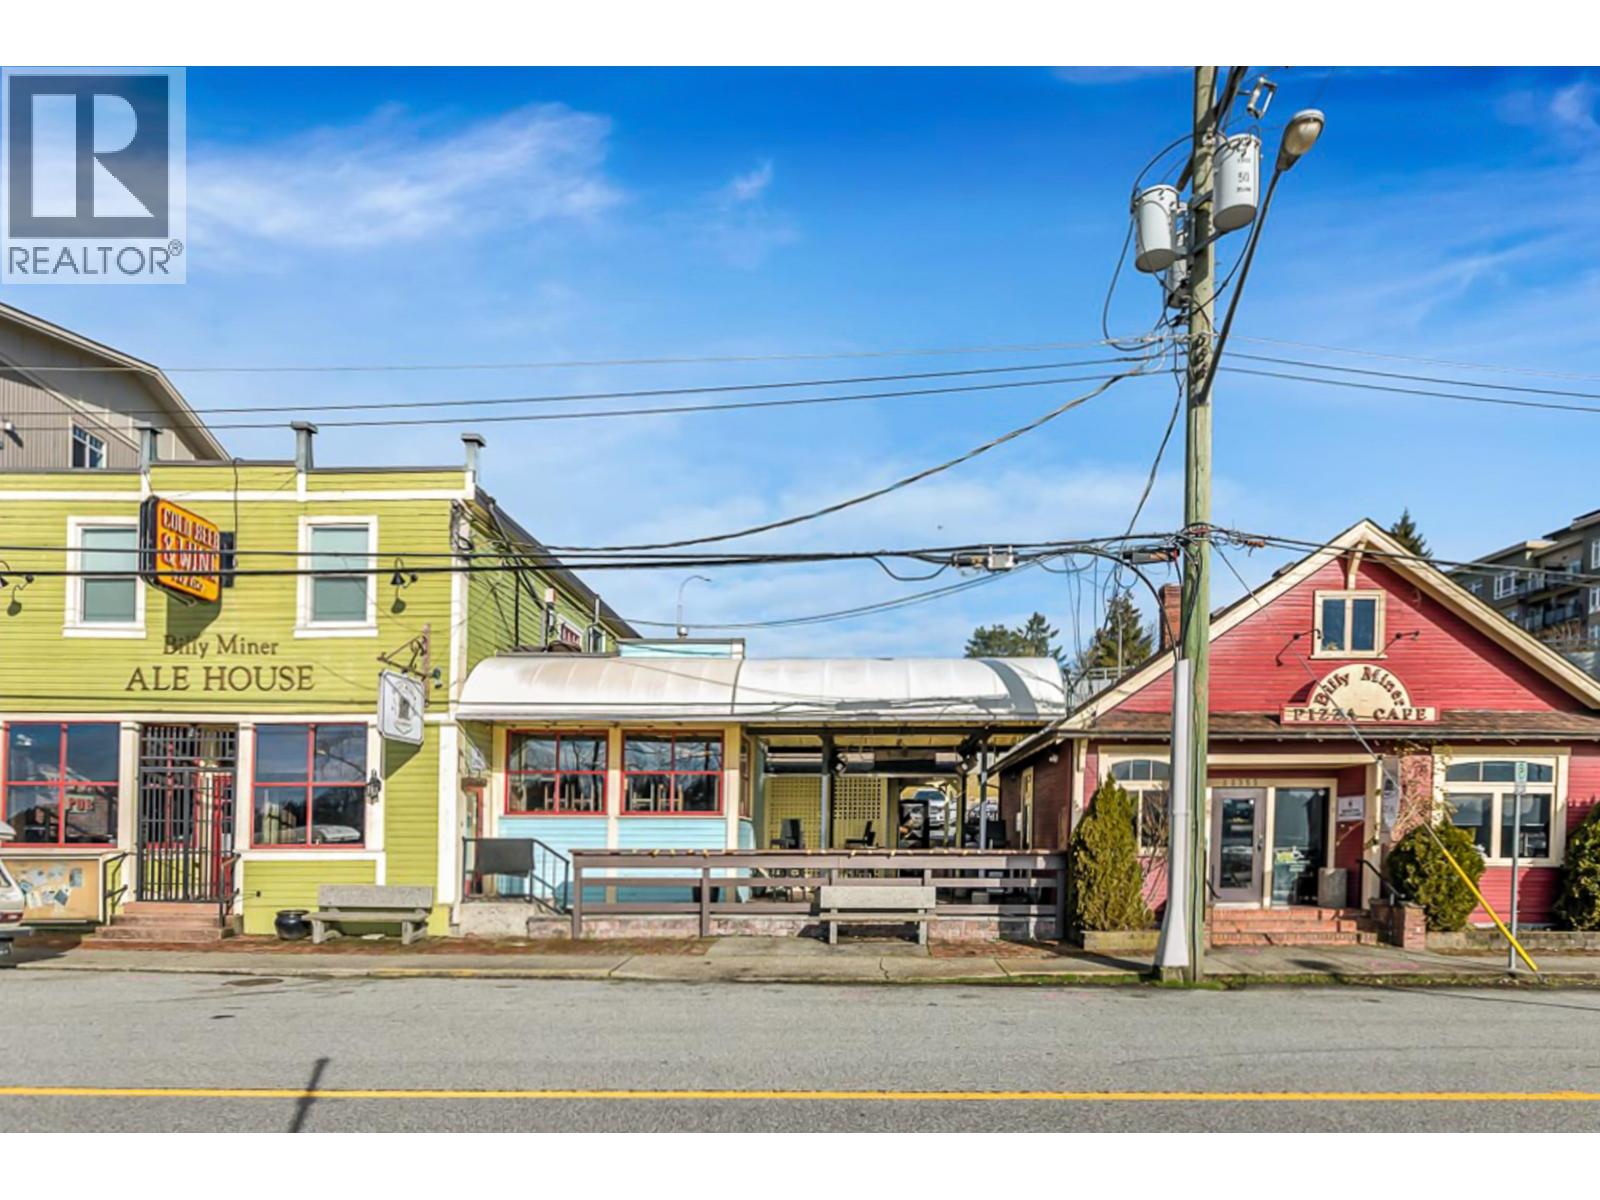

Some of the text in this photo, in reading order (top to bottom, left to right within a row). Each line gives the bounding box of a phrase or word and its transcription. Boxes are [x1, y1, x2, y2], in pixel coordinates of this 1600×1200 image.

[163, 634, 279, 659] Billy Miner
[125, 665, 316, 692] ALE HOUSE
[1314, 666, 1405, 707] Billy Miner
[1293, 707, 1427, 722] PIZZA CAFE
